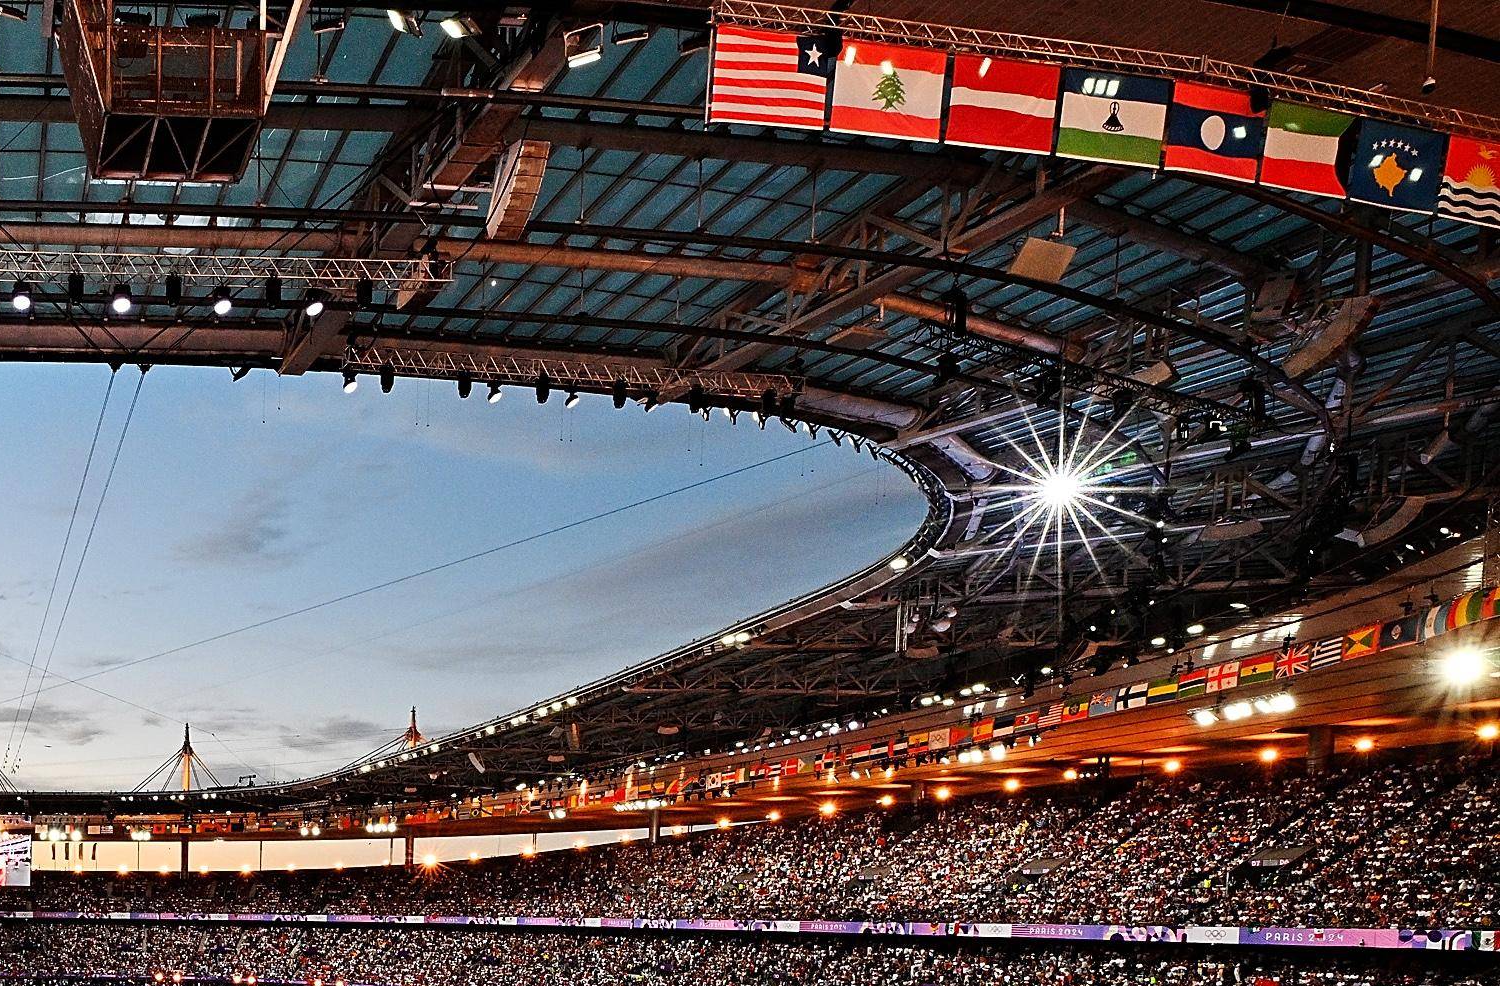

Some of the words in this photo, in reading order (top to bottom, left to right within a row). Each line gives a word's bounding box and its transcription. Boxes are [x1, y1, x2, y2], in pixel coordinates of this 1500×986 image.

[1028, 927, 1055, 935] PARIS
[1058, 927, 1083, 936] 2024
[1265, 932, 1303, 942] PARIS
